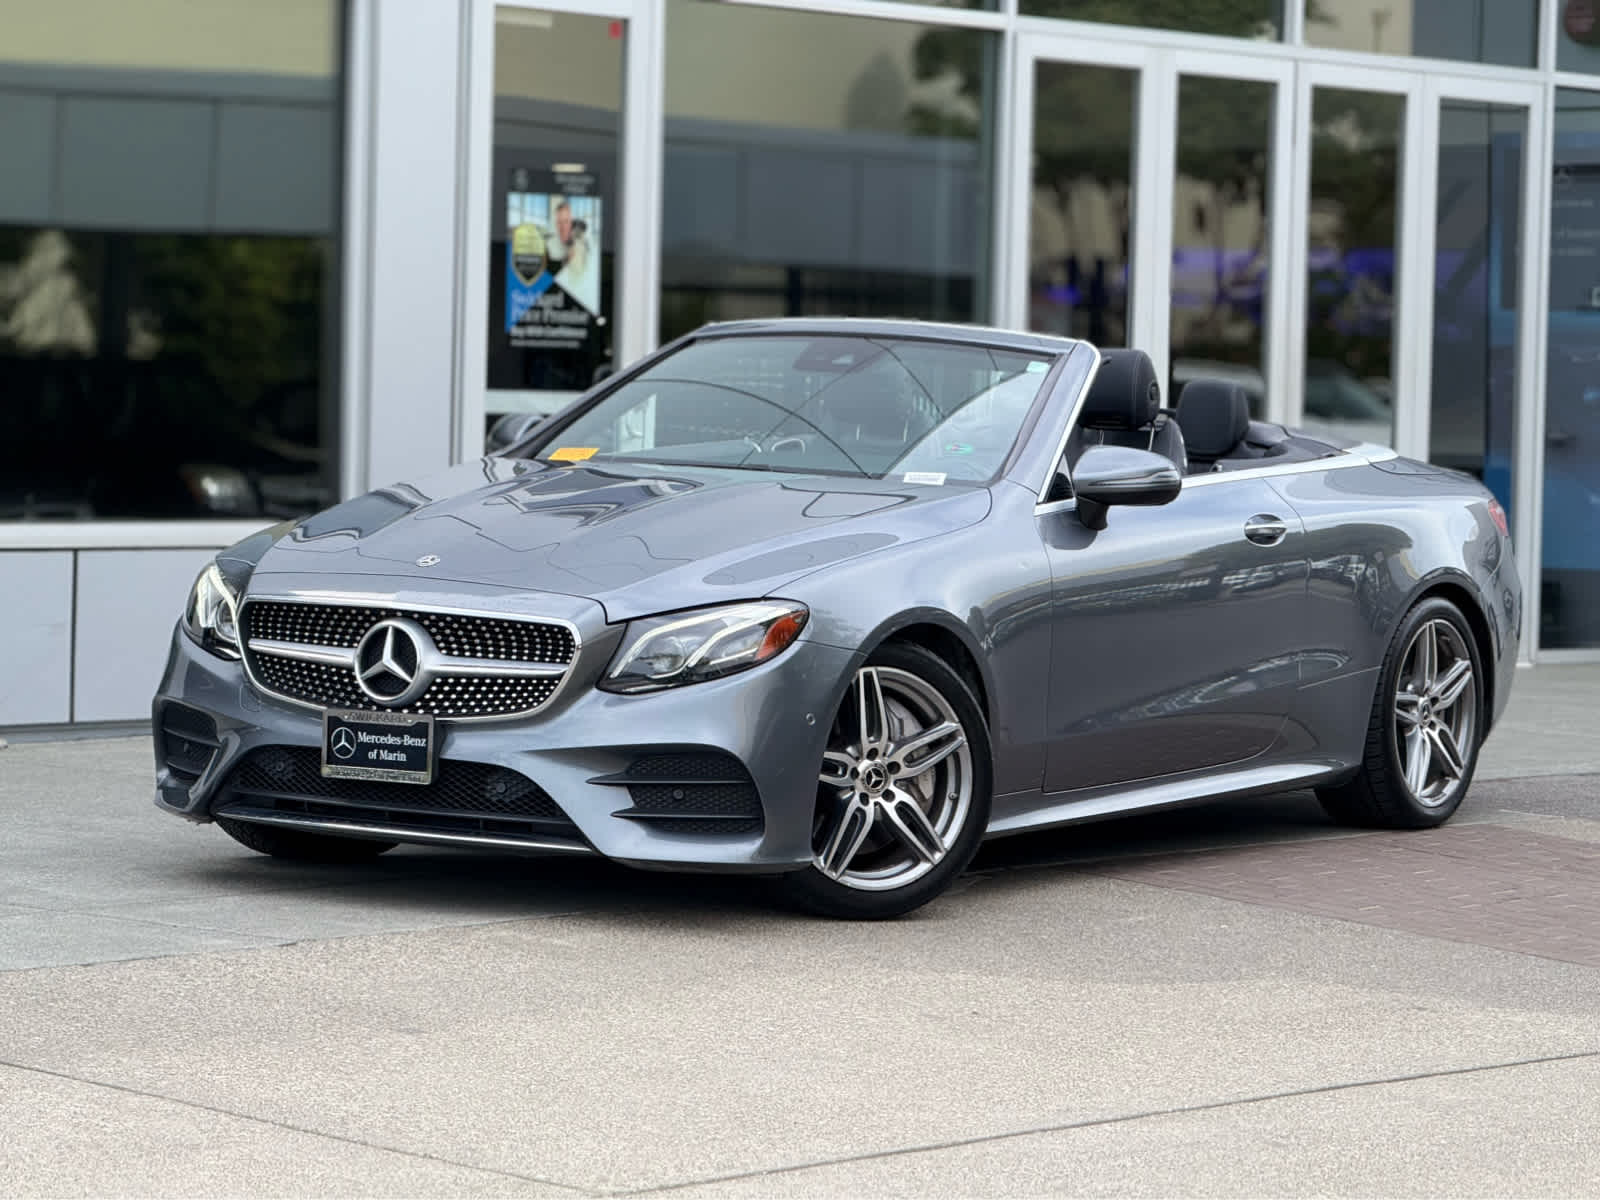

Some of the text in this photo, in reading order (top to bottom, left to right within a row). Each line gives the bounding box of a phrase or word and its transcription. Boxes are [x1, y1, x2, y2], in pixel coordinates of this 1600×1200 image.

[357, 731, 427, 747] Mercedes-Benz
[367, 749, 407, 761] of Marin
